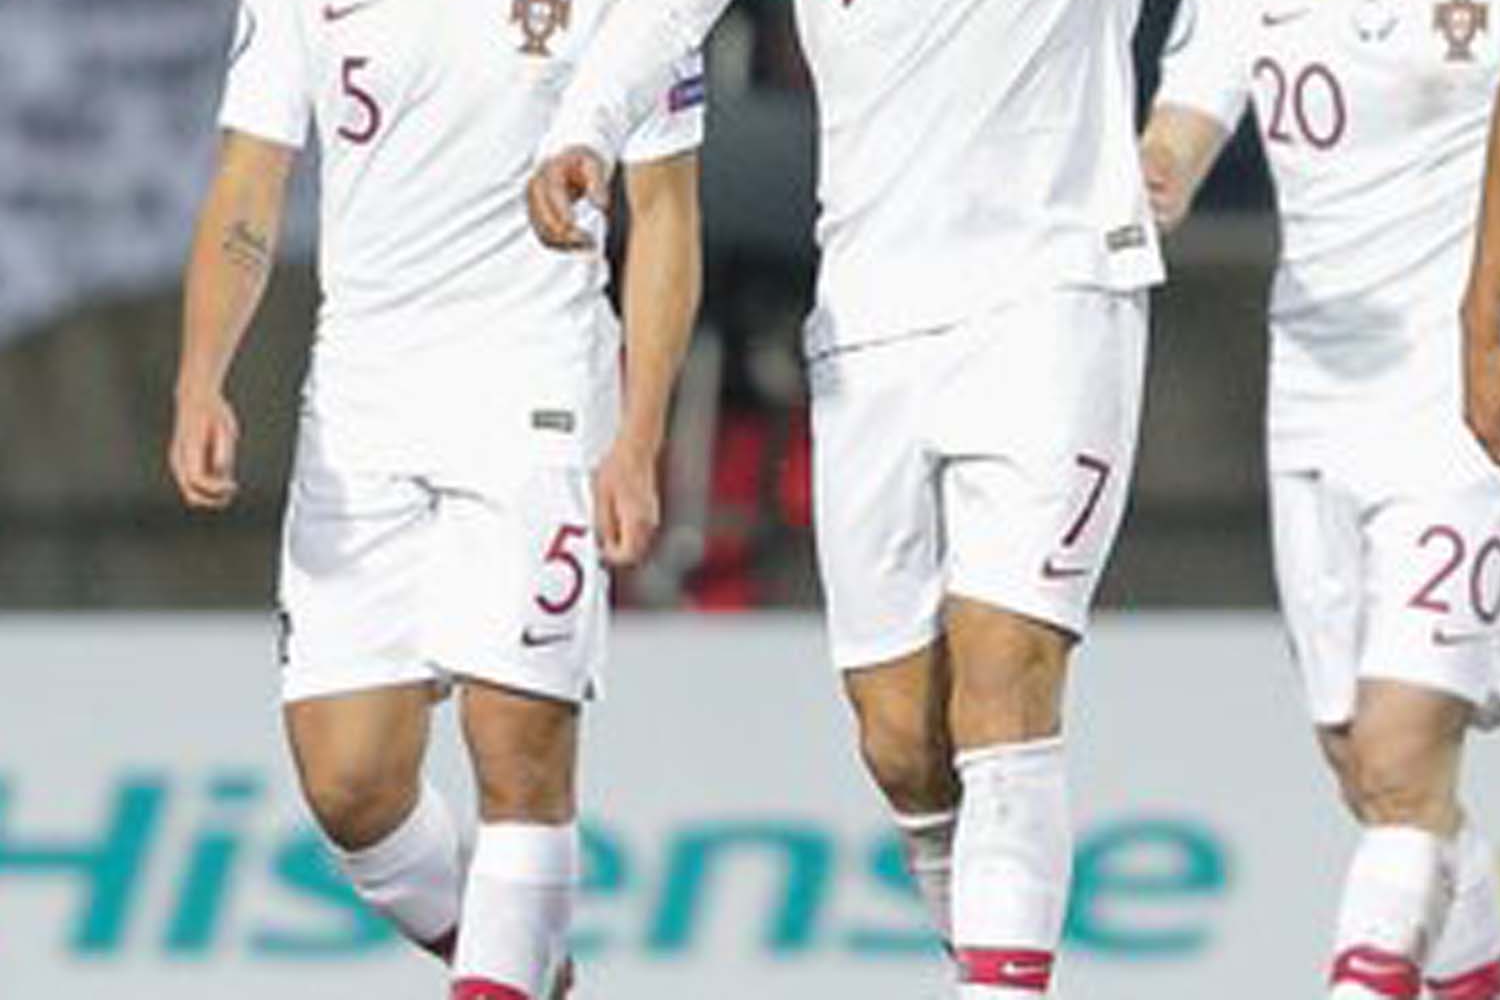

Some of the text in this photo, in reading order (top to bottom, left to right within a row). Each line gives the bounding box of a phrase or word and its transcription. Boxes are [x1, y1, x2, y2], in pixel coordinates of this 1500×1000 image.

[336, 56, 382, 145] 5
[1251, 56, 1347, 151] 20
[1060, 453, 1111, 547] 7
[533, 523, 588, 615] 5
